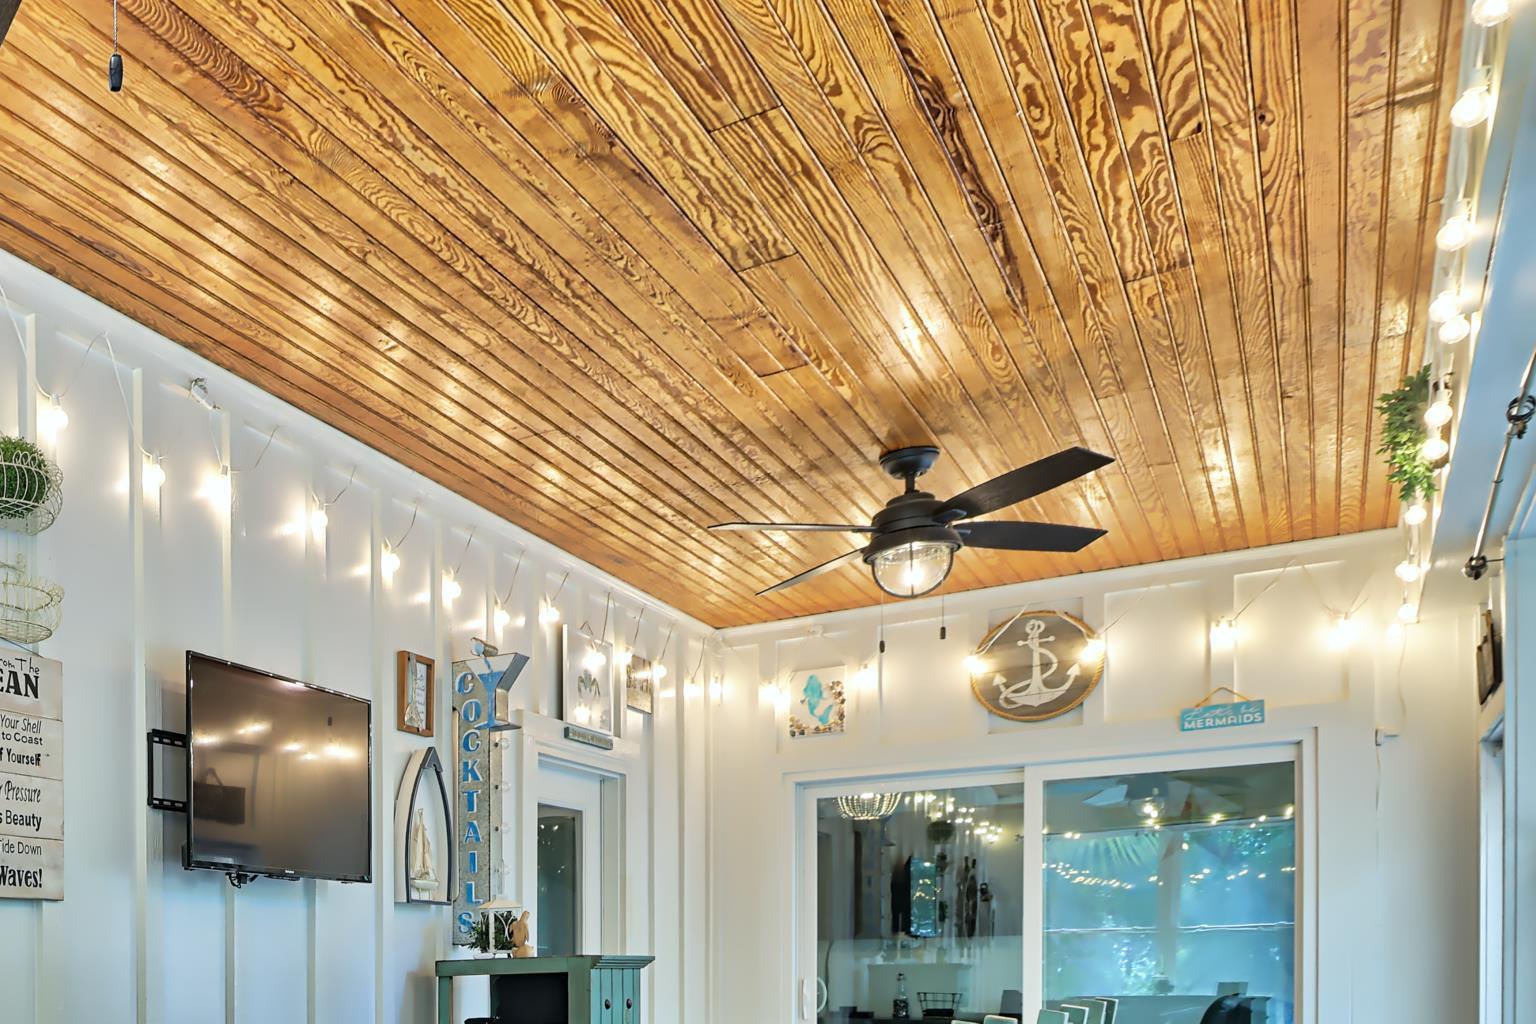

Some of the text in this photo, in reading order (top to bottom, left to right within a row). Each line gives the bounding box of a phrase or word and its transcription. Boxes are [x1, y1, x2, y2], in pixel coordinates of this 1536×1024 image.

[15, 656, 40, 675] The
[0, 714, 19, 729] Your
[21, 718, 42, 734] Shell
[1183, 712, 1262, 730] MERMAIDS
[2, 731, 12, 741] to
[13, 732, 43, 746] Coast
[6, 748, 41, 766] Yourself
[4, 780, 41, 803] Pressure
[455, 672, 483, 934] COCKTAILS
[5, 810, 42, 831] Beauty
[17, 841, 42, 856] Down
